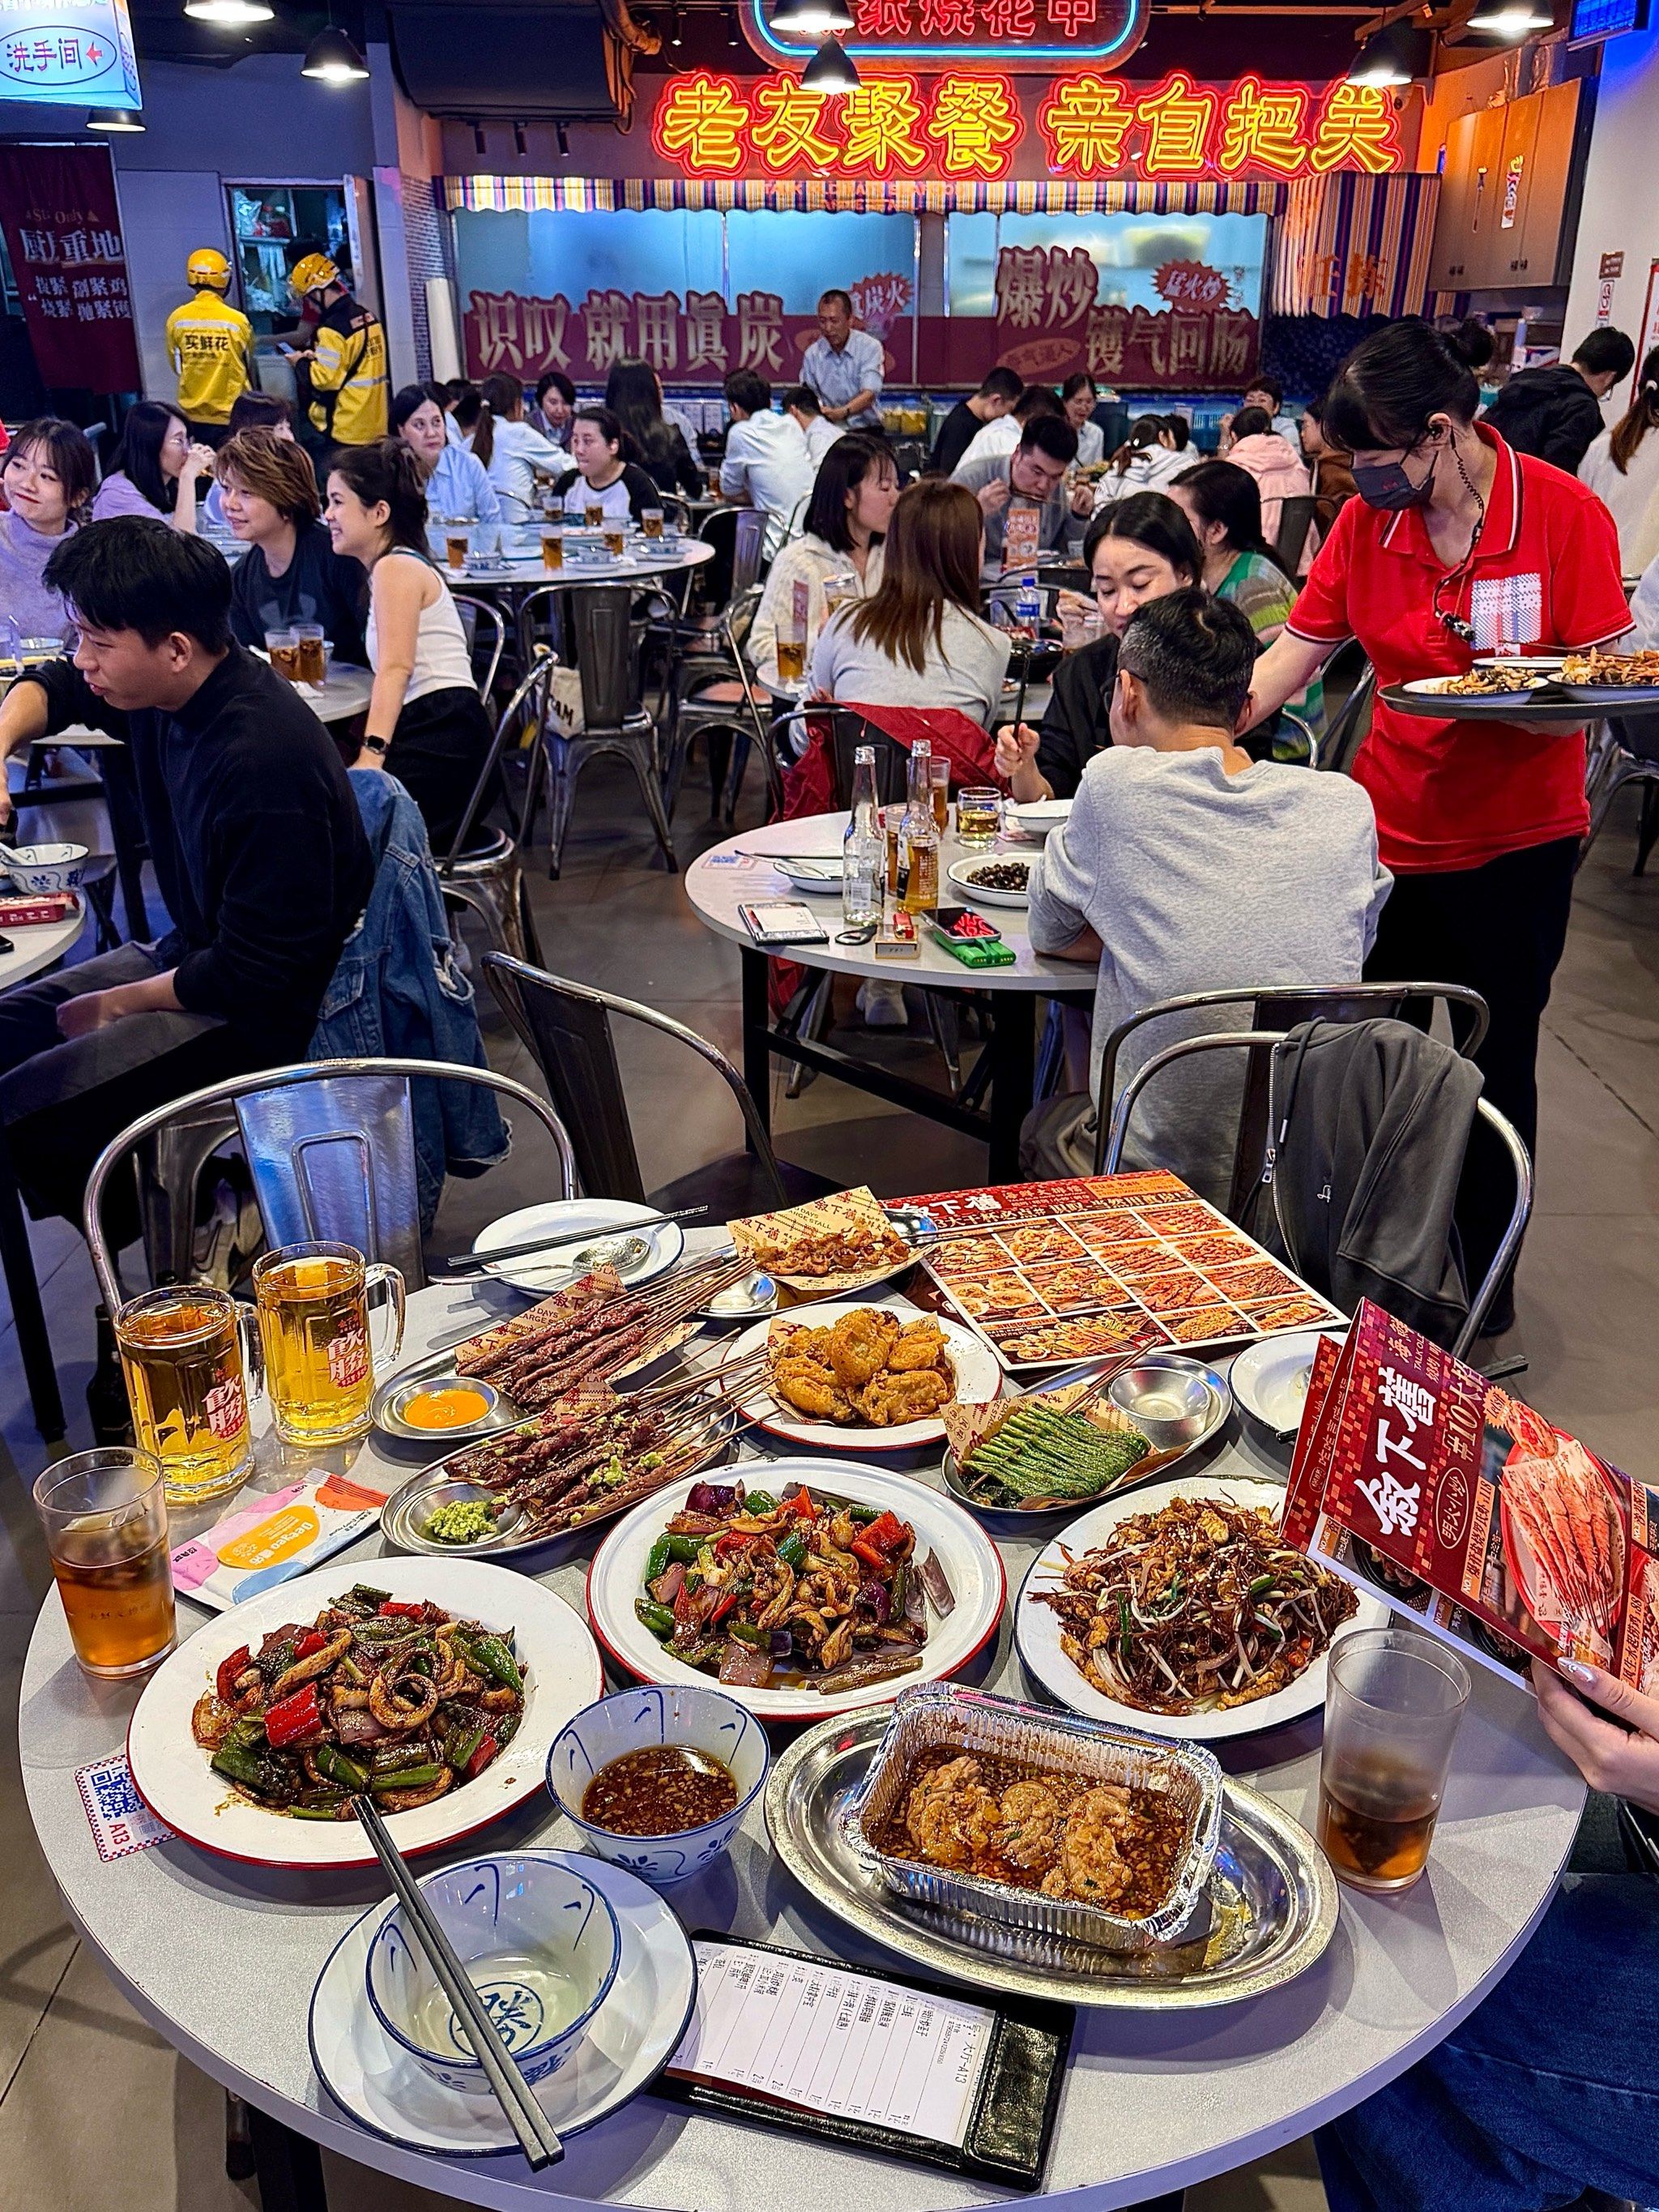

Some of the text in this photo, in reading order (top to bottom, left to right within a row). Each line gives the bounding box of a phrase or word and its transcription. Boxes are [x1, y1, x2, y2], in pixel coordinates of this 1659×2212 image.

[6, 38, 83, 73] 洗手间
[658, 75, 1397, 173] 老友聚餐 亲自把关
[996, 246, 1097, 329] 爆炒
[1085, 304, 1252, 376] 镬气回肠
[1354, 1366, 1438, 1536] 叙下舊
[1444, 1475, 1466, 1540] 明火小炒
[109, 1822, 130, 1846] A13
[954, 2041, 975, 2084] 大厅-A13
